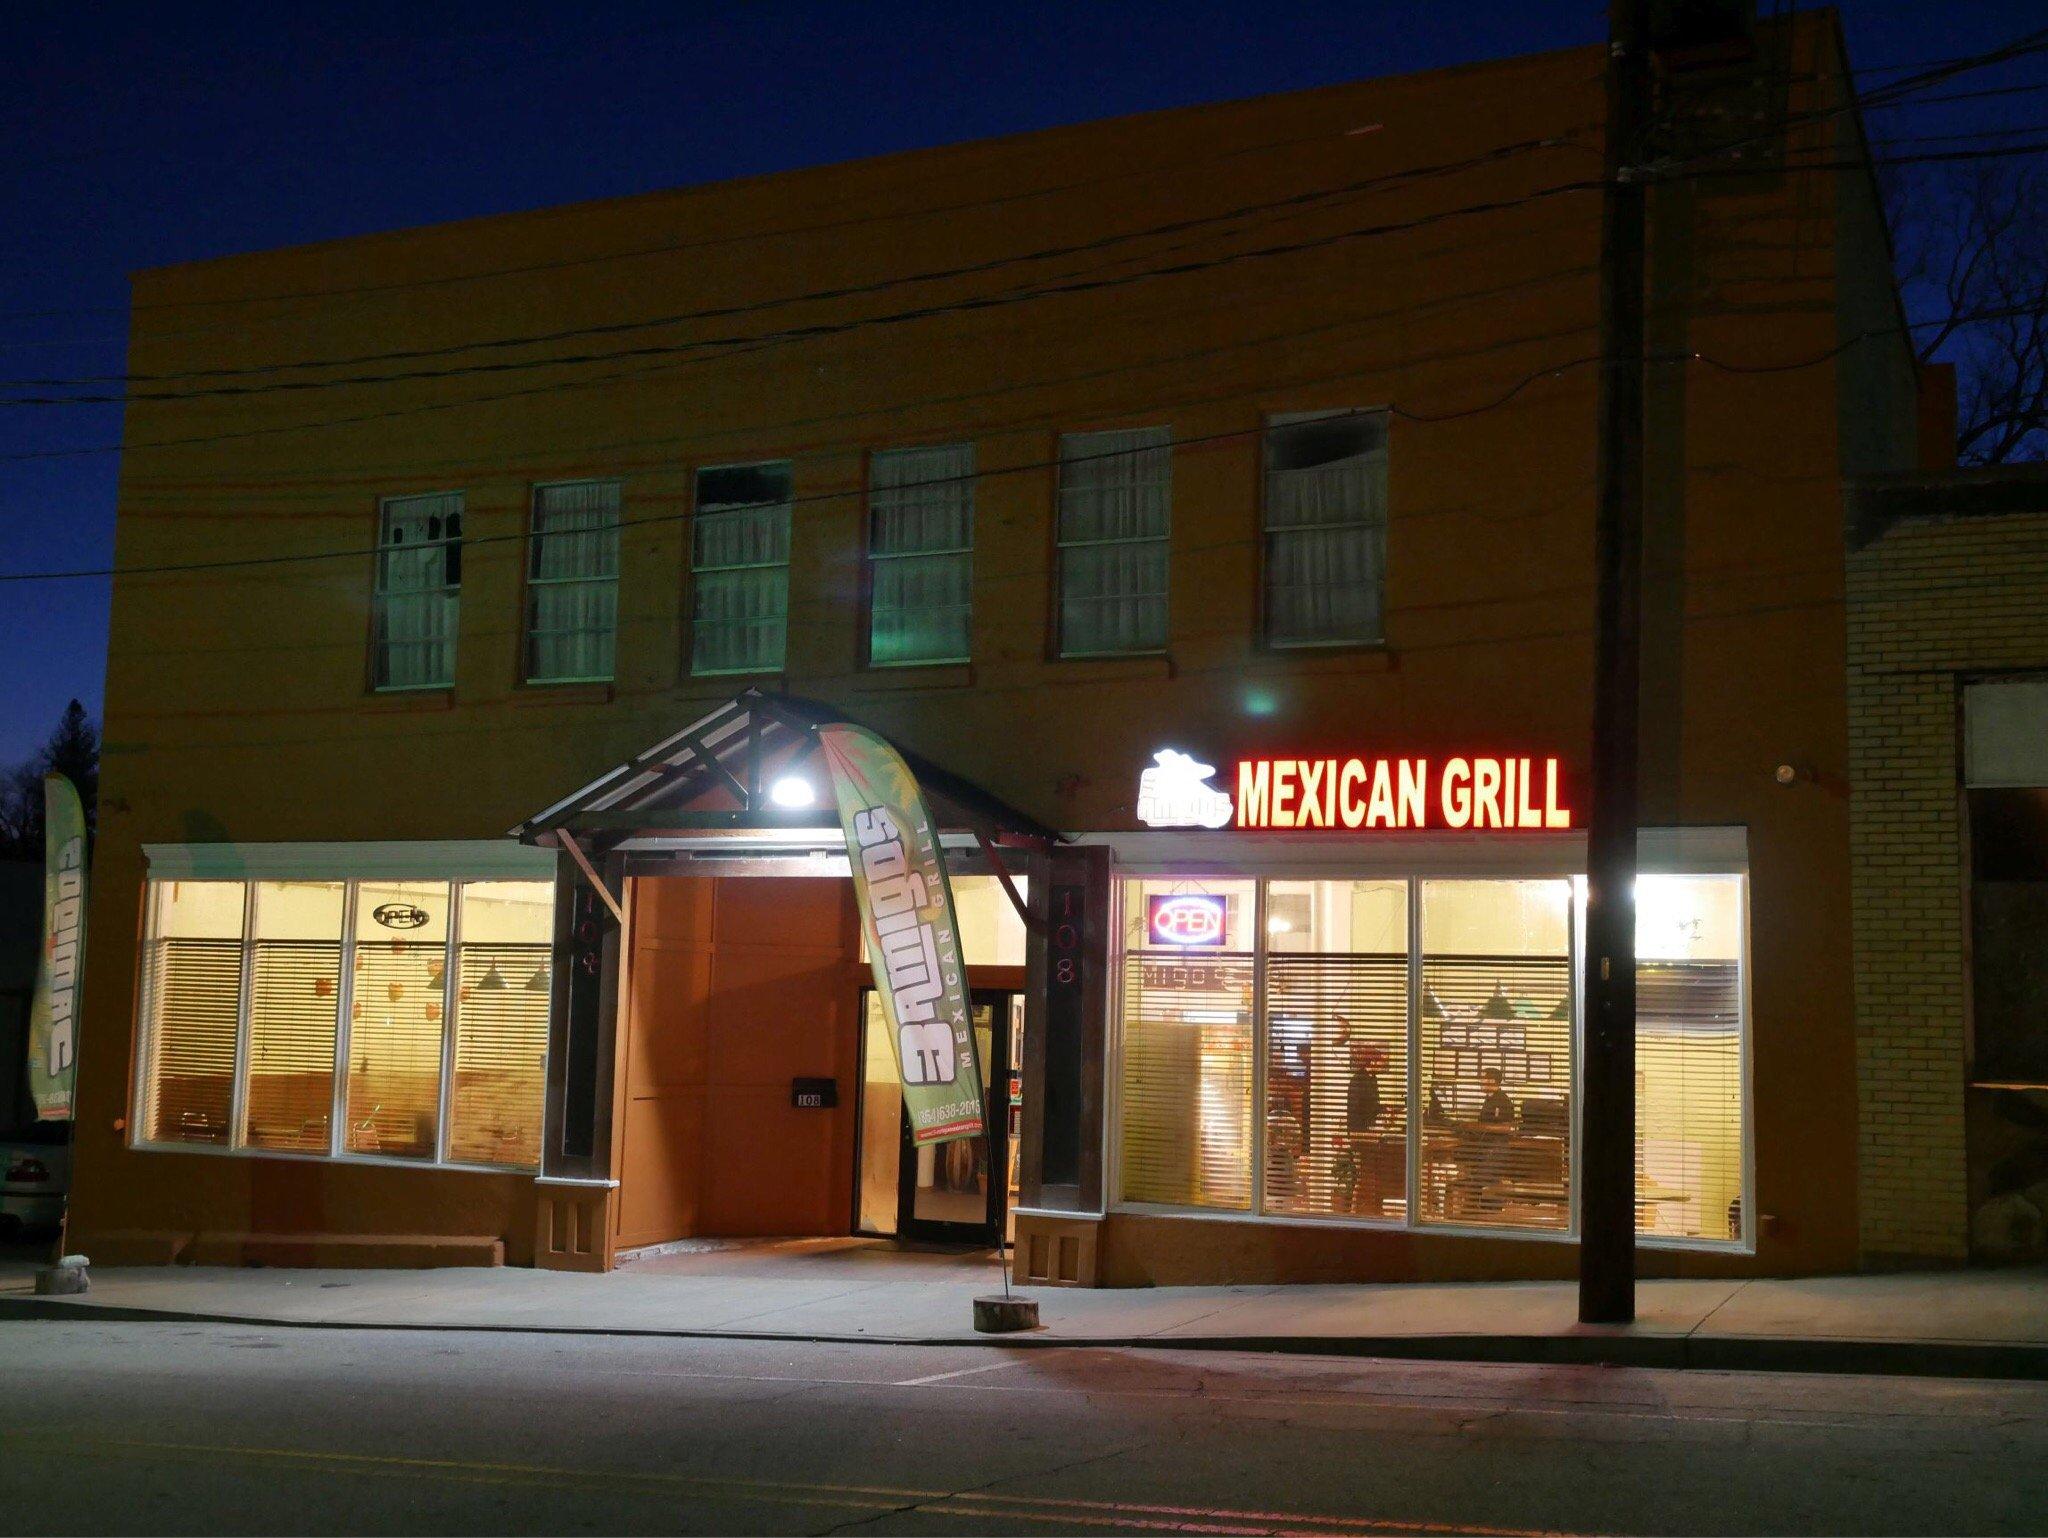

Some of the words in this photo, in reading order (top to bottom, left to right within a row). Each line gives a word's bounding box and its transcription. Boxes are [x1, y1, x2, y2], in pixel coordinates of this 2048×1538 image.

[1238, 759, 1426, 828] MEXICAN
[1442, 758, 1571, 828] GRILL
[918, 820, 944, 908] GRILL
[1056, 889, 1078, 984] 108
[1155, 908, 1221, 932] OPEN
[939, 930, 972, 1068] MEXICAN
[800, 1096, 820, 1106] 108
